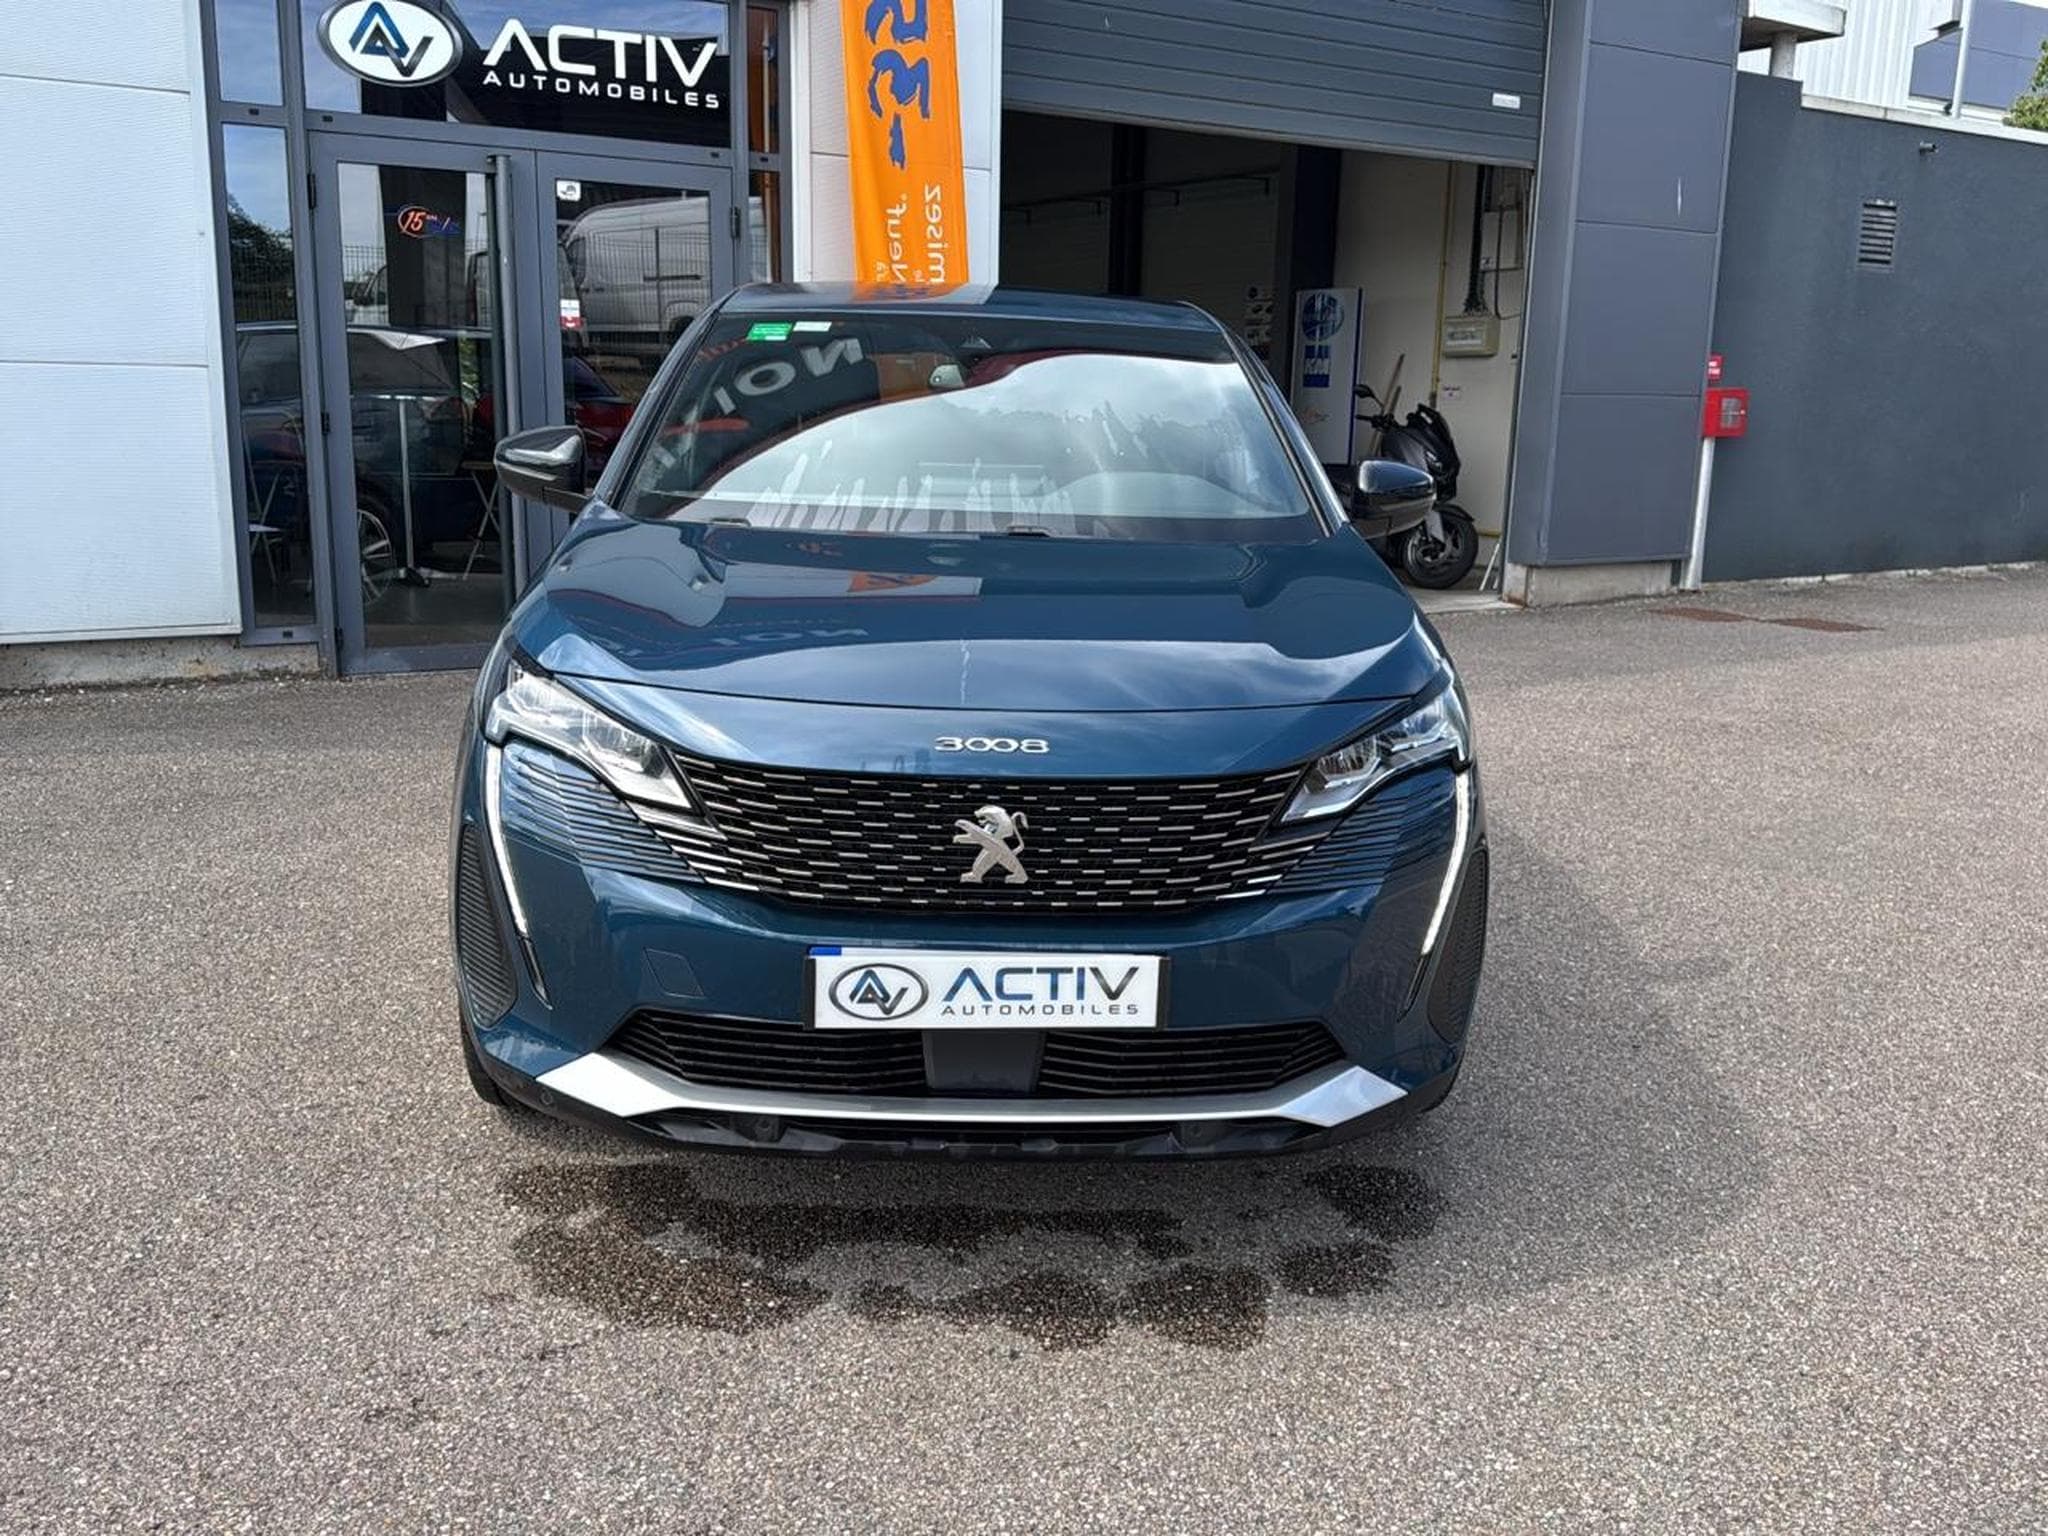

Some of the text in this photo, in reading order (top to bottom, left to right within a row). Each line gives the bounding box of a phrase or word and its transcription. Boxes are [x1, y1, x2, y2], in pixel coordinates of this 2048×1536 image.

[483, 18, 718, 87] ACTIV
[483, 70, 719, 109] AUTOMOBILES
[934, 736, 1050, 753] 3008
[942, 966, 1140, 1001] ACTIV
[941, 1004, 1139, 1016] AUTOMOBILES
